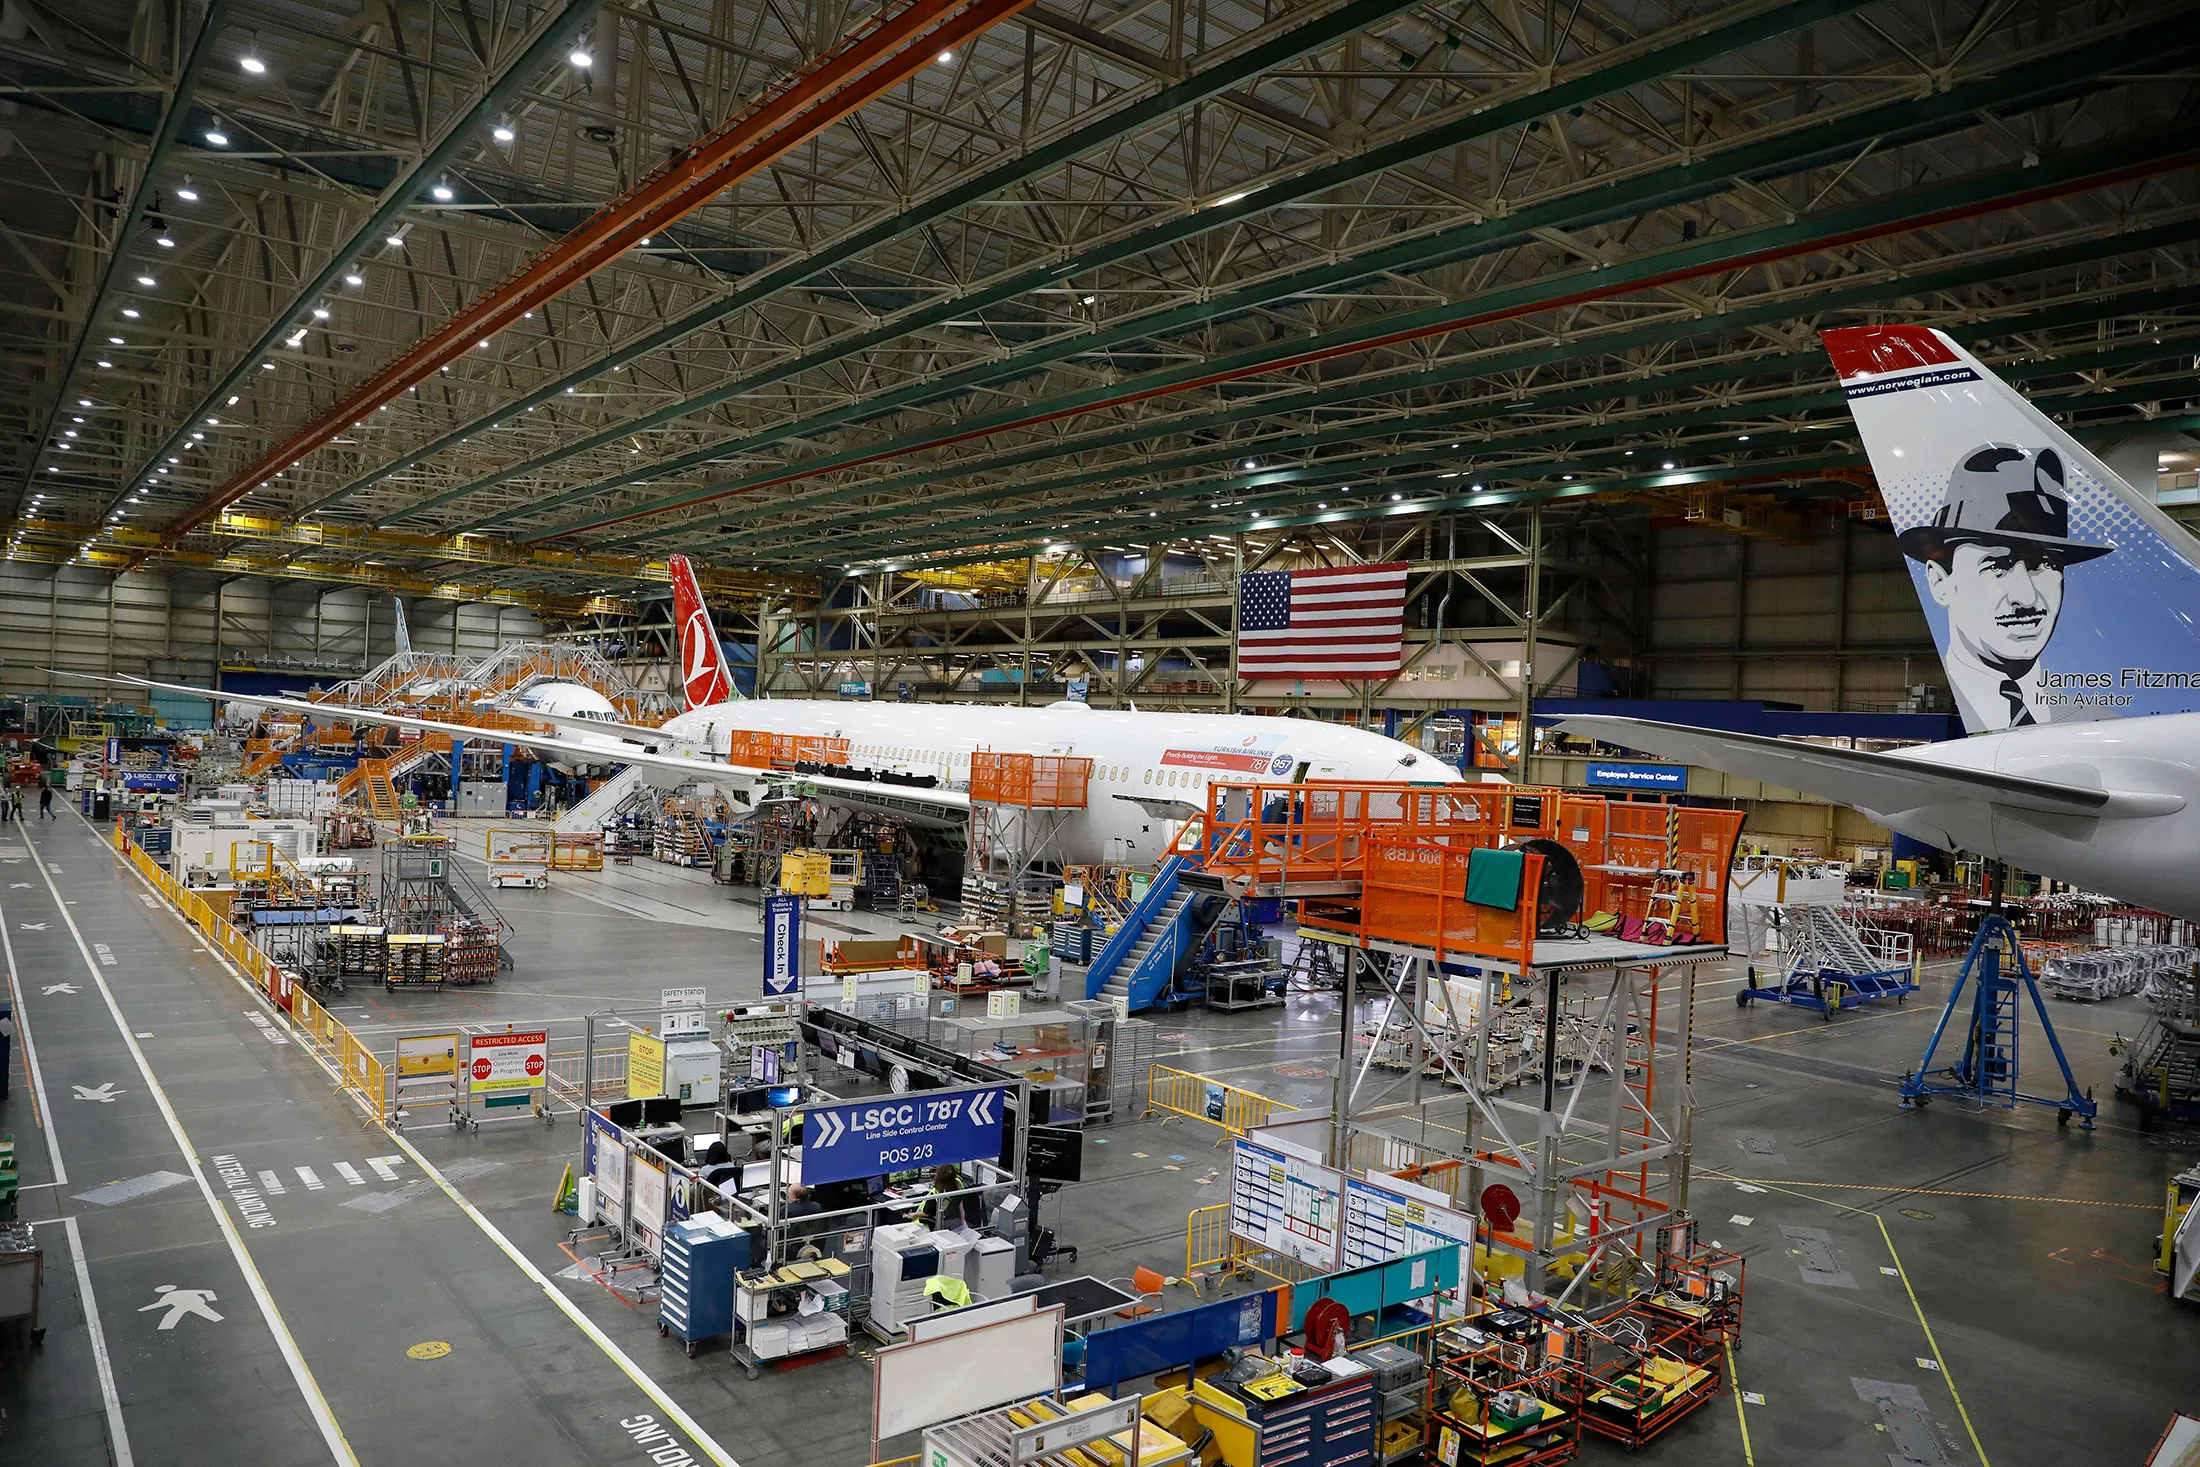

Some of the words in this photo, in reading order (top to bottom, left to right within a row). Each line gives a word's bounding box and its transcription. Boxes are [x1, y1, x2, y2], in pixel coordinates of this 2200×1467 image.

[1848, 371, 1971, 396] www.norwegian.com
[1865, 509, 1874, 518] 32
[2036, 669, 2112, 688] James
[2035, 692, 2068, 705] Irish
[2073, 692, 2133, 706] Aviator
[1213, 746, 1241, 754] TURKISH
[1242, 747, 1274, 757] AIRLINES
[1249, 758, 1269, 770] 787
[1273, 759, 1293, 769] 957
[1596, 770, 1628, 780] Employee
[1629, 772, 1654, 780] Service
[1655, 773, 1679, 781] Center
[777, 924, 786, 960] Check
[777, 964, 785, 974] In
[684, 988, 705, 996] STATION
[475, 1036, 516, 1046] RESTRICTED
[517, 1035, 543, 1043] ACCESS
[638, 1044, 655, 1057] STOP!
[472, 1064, 492, 1074] STOP
[493, 1059, 524, 1067] Operations
[526, 1060, 544, 1070] STOP
[500, 1067, 524, 1075] Progress
[851, 1104, 914, 1132] LSCC
[926, 1098, 963, 1122] 787
[865, 1130, 881, 1140] Line
[882, 1128, 898, 1138] Side
[899, 1125, 925, 1136] Control
[925, 1122, 948, 1133] Center
[879, 1148, 909, 1165] POS
[913, 1144, 933, 1161] 2/3
[1398, 1137, 1410, 1145] DOOR
[1414, 1142, 1432, 1152] RIGGING
[1432, 1147, 1447, 1156] STAND
[1452, 1154, 1465, 1162] RIGHT
[1466, 1158, 1477, 1167] UNIT
[211, 1153, 252, 1189] MATERIAL
[230, 1187, 277, 1228] HANDLING
